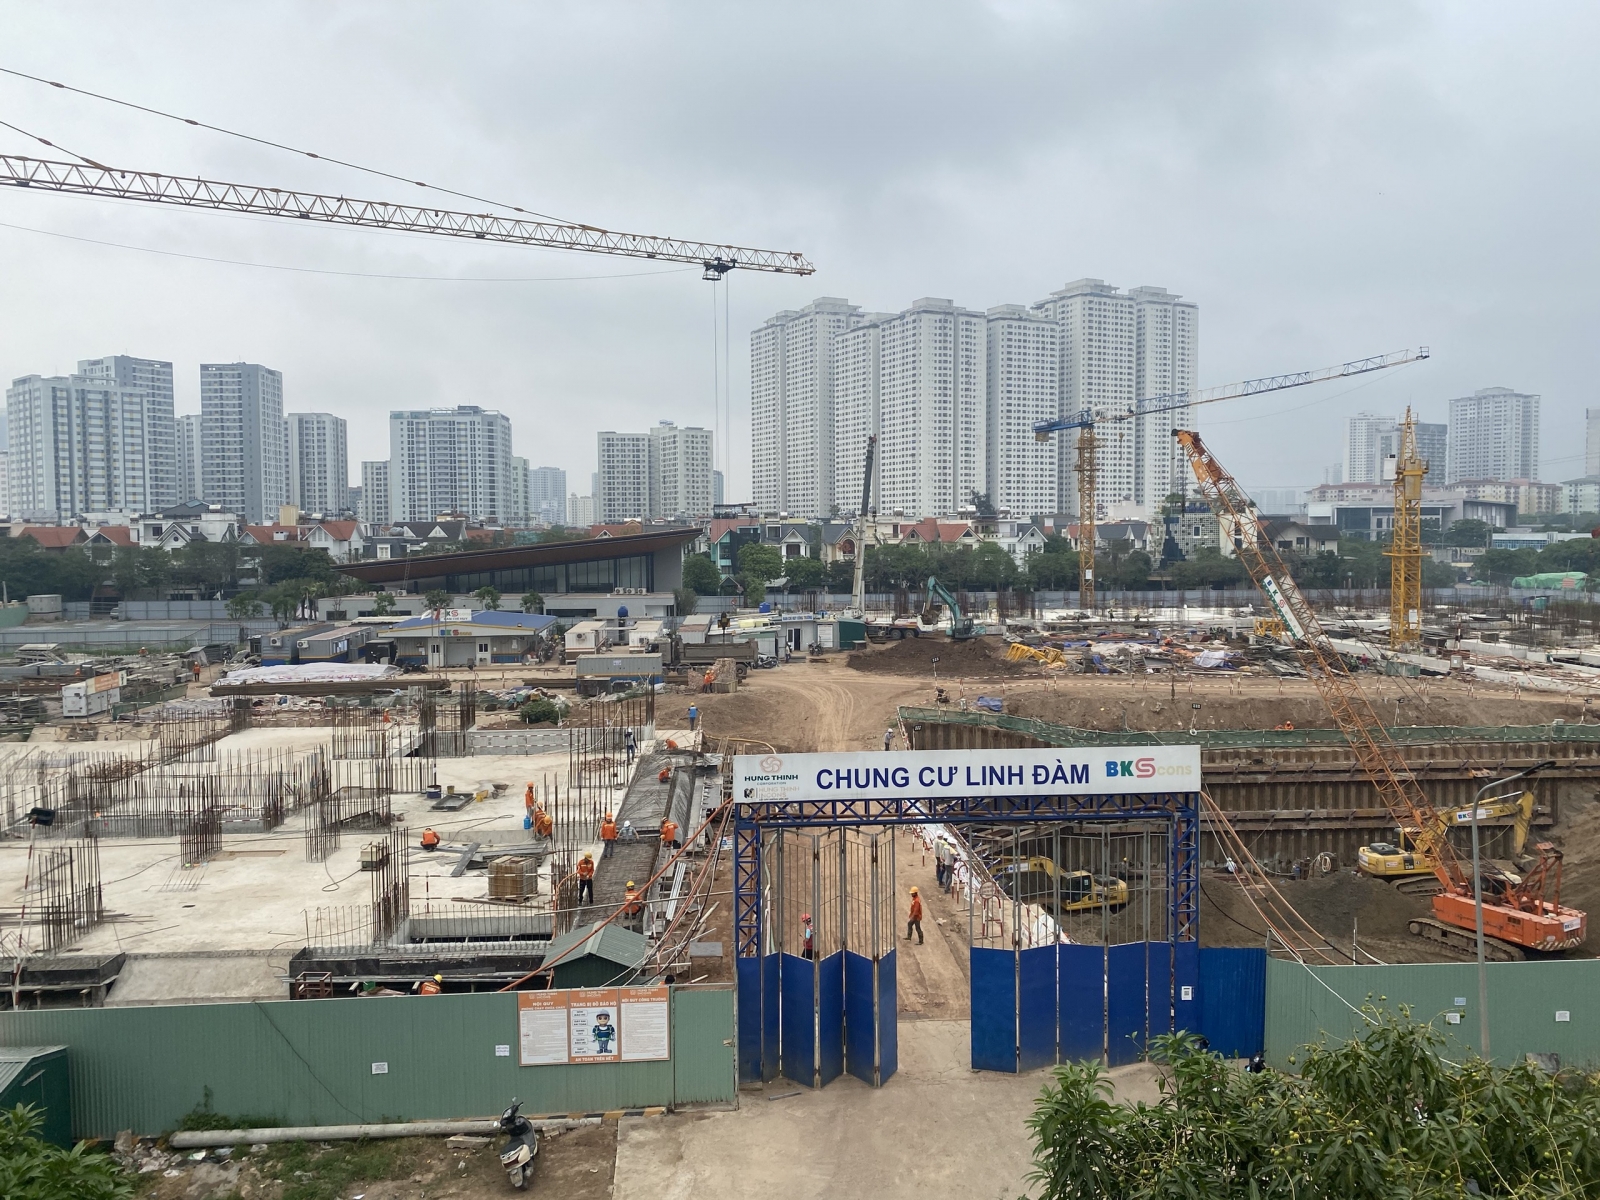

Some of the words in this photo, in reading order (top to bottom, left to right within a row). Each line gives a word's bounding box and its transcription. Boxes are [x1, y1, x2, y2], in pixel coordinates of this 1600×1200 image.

[816, 767, 910, 789] CHUNG
[918, 766, 958, 787] CƯ
[966, 765, 1023, 786] LINH
[1032, 759, 1089, 784] ĐÀM
